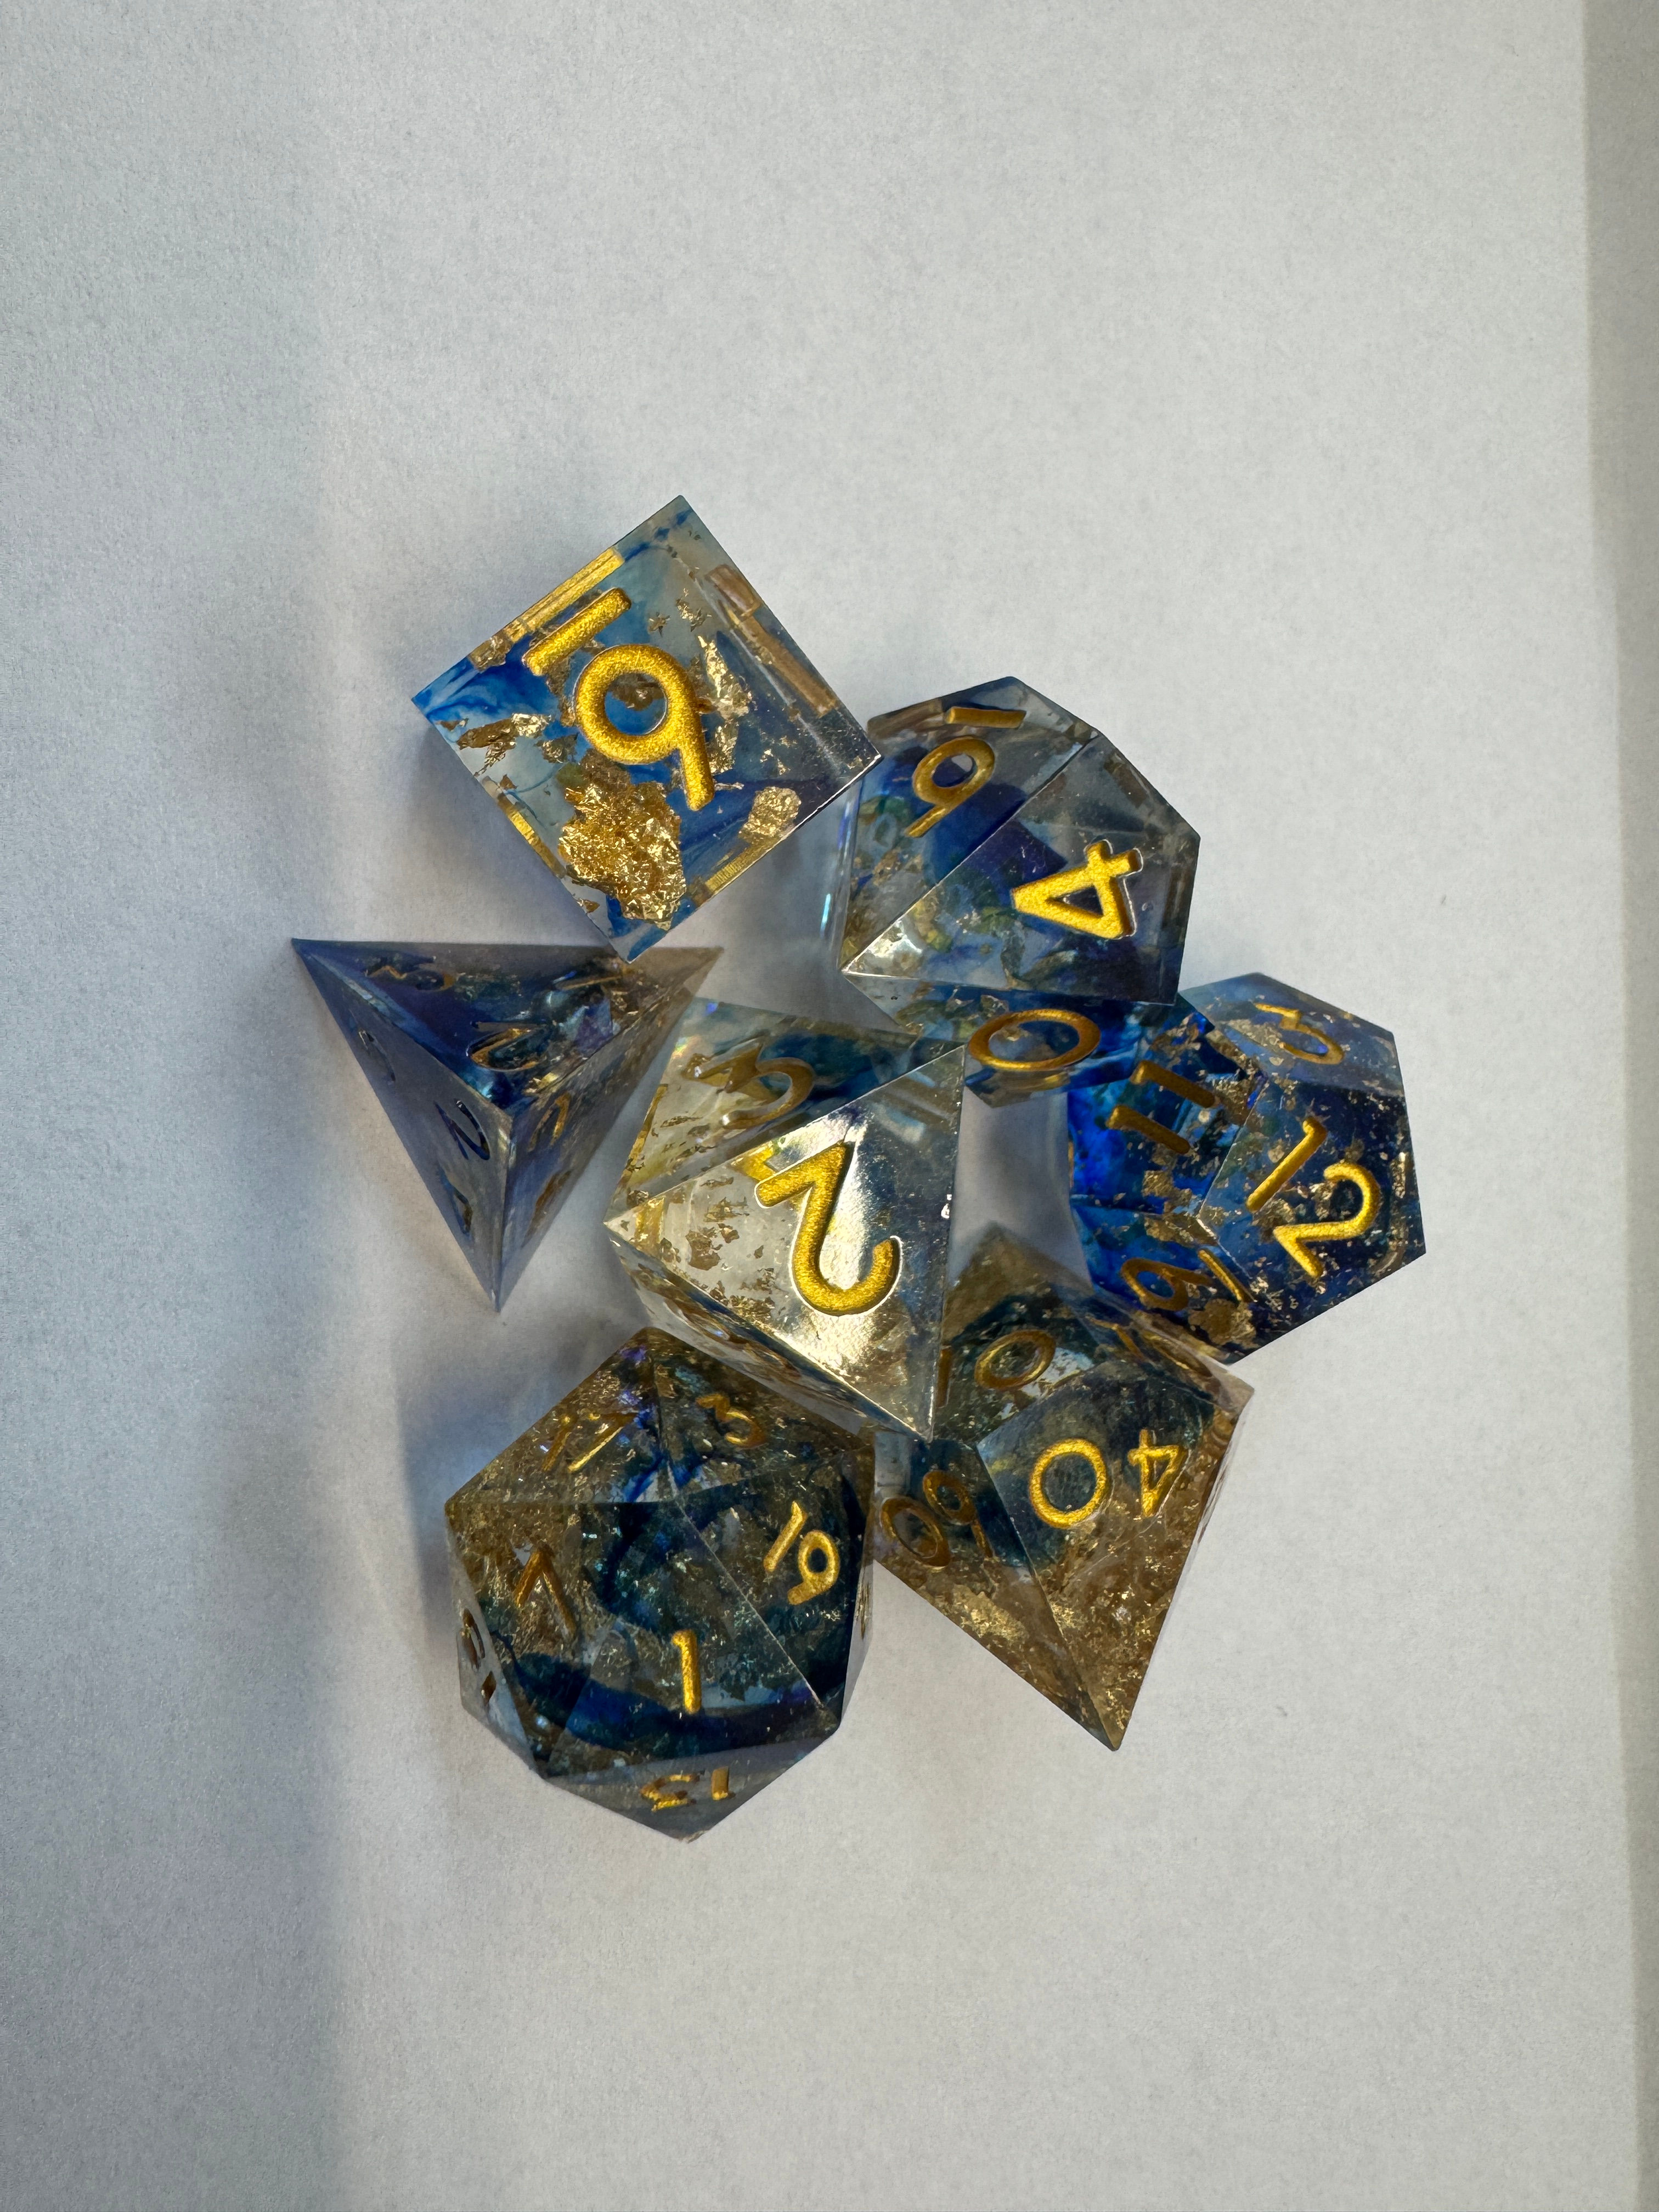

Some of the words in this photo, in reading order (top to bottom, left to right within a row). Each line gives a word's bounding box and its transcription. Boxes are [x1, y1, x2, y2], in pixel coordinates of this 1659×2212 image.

[1011, 839, 1143, 940] 4
[968, 1009, 1101, 1072] 0
[754, 1141, 902, 1316] 2
[1246, 1115, 1380, 1279] 12
[1029, 1428, 1188, 1531] 40
[763, 1500, 840, 1606] 19
[673, 1629, 701, 1714] 1
